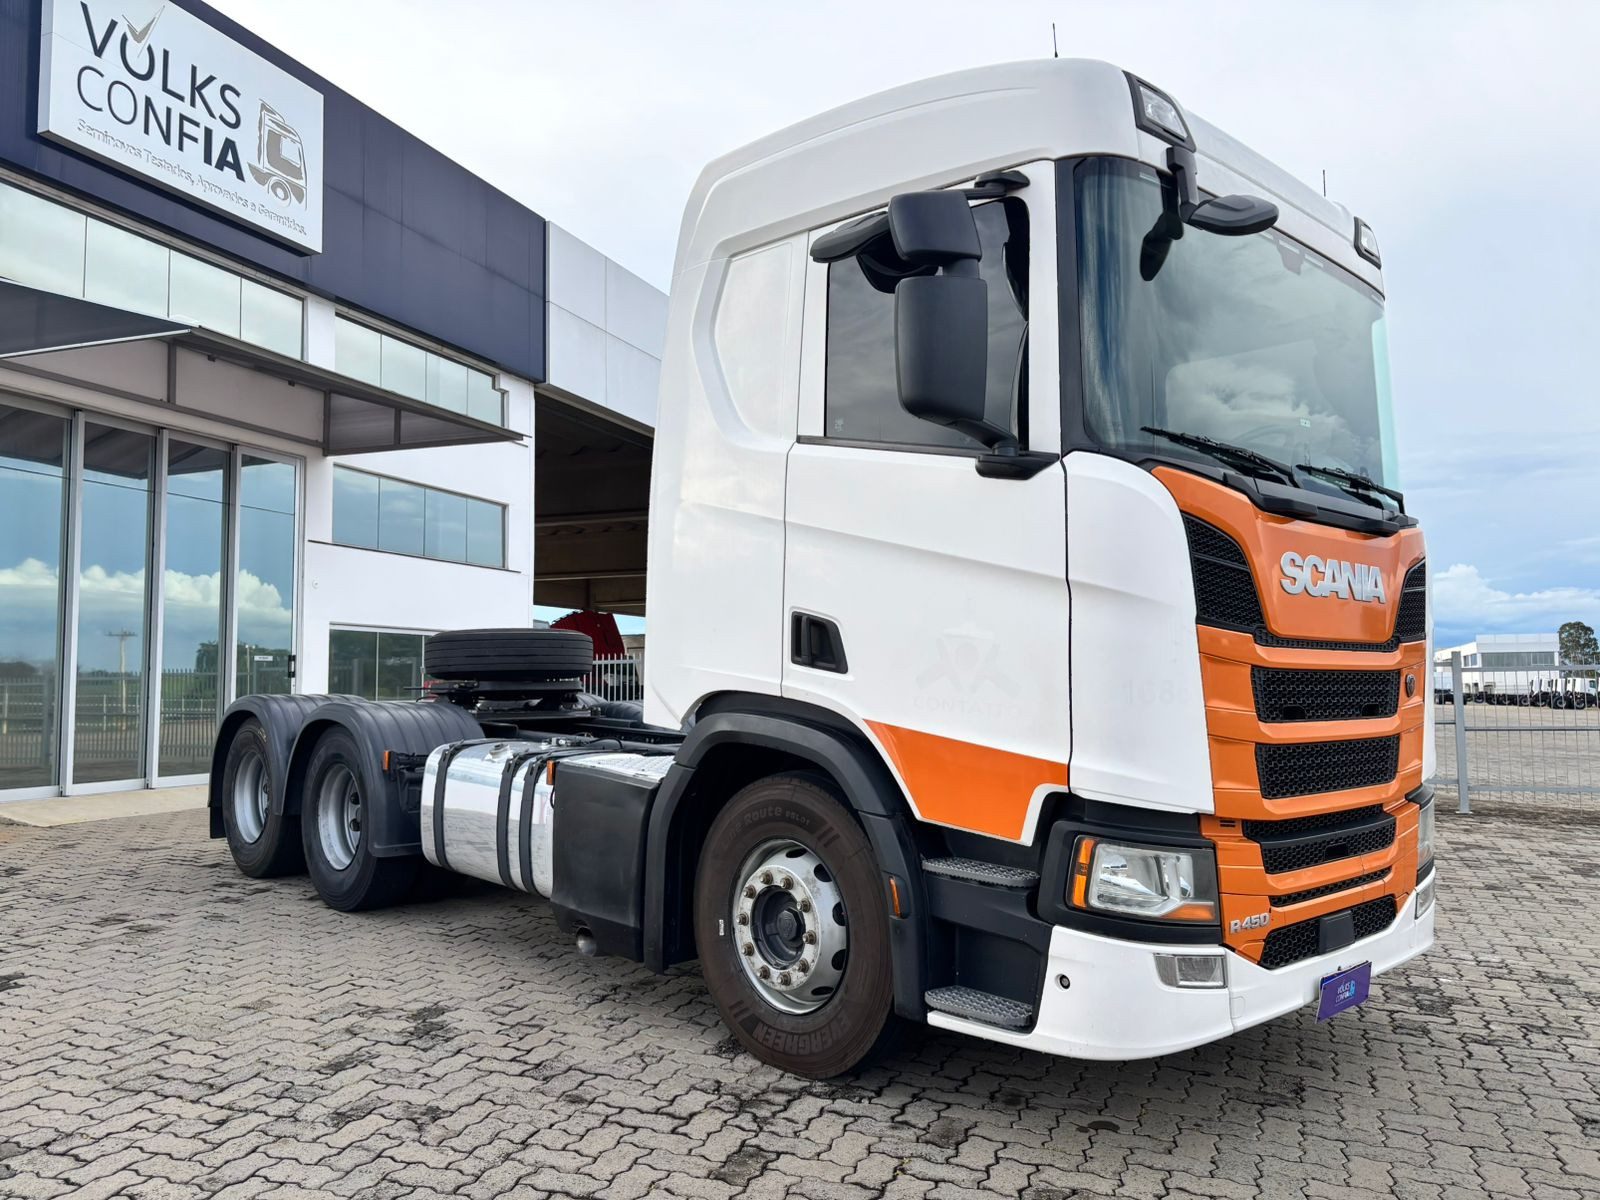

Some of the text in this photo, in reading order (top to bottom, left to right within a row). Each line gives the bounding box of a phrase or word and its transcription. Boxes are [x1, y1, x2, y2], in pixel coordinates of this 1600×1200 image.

[80, 1, 242, 130] VOLKS
[77, 65, 246, 183] CONFIA
[78, 118, 142, 159] Seminovos
[143, 148, 195, 186] Testados,
[197, 174, 249, 208] Aprovados
[1280, 551, 1386, 604] SCANIA
